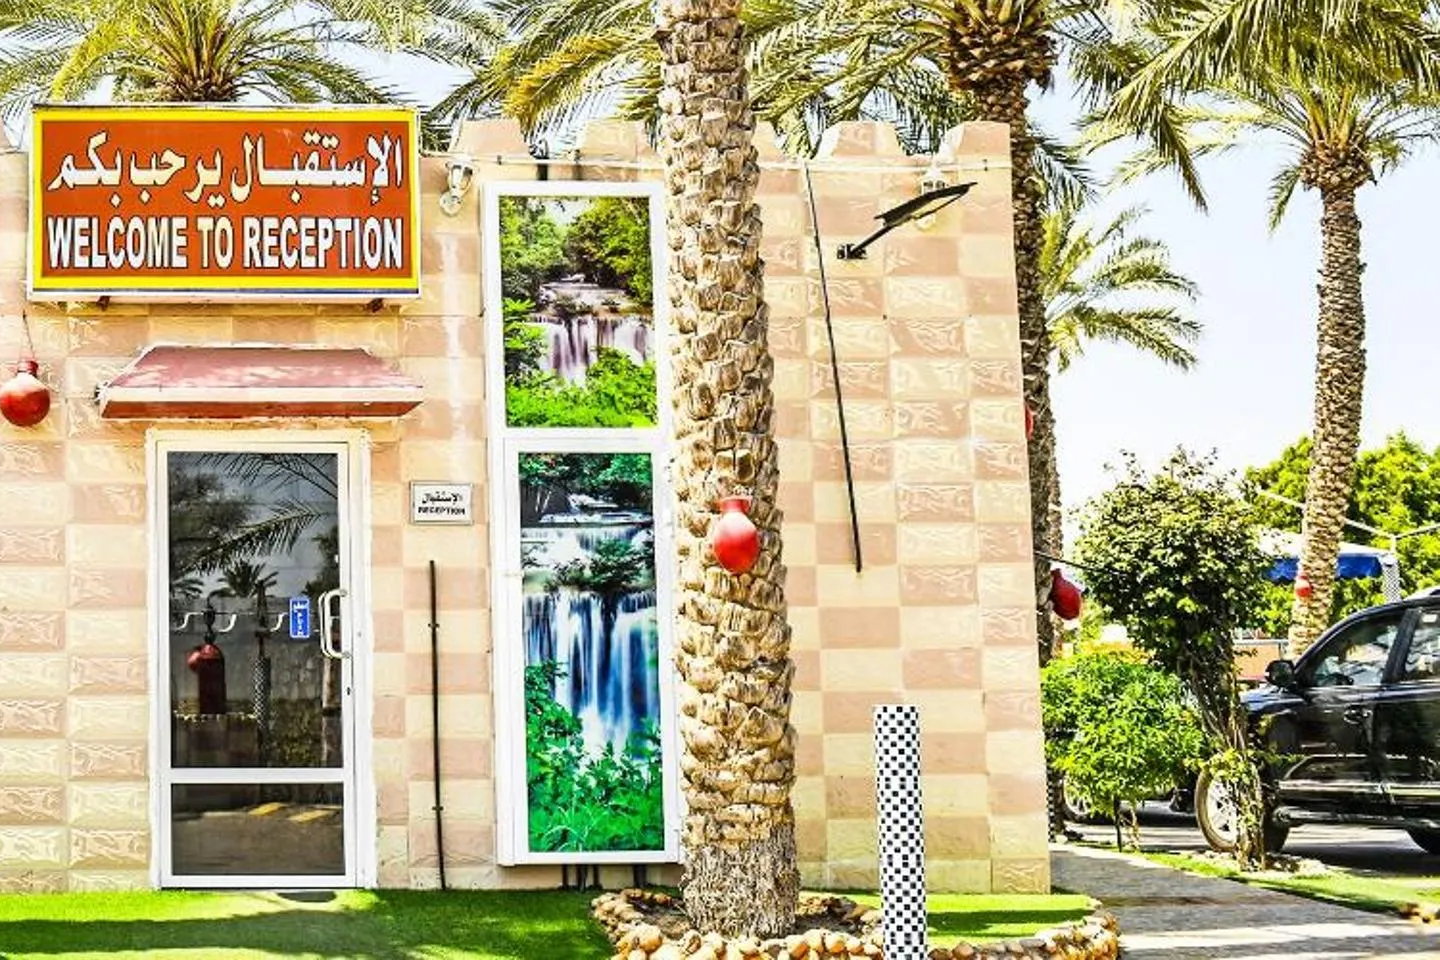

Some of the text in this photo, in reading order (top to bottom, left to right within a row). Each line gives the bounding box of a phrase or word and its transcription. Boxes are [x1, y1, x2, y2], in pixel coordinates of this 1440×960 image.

[47, 129, 403, 208] الإستقبال يرحب بكم
[46, 215, 403, 270] WELCOME TO RECEPTION
[418, 506, 466, 515] RECEPTION
